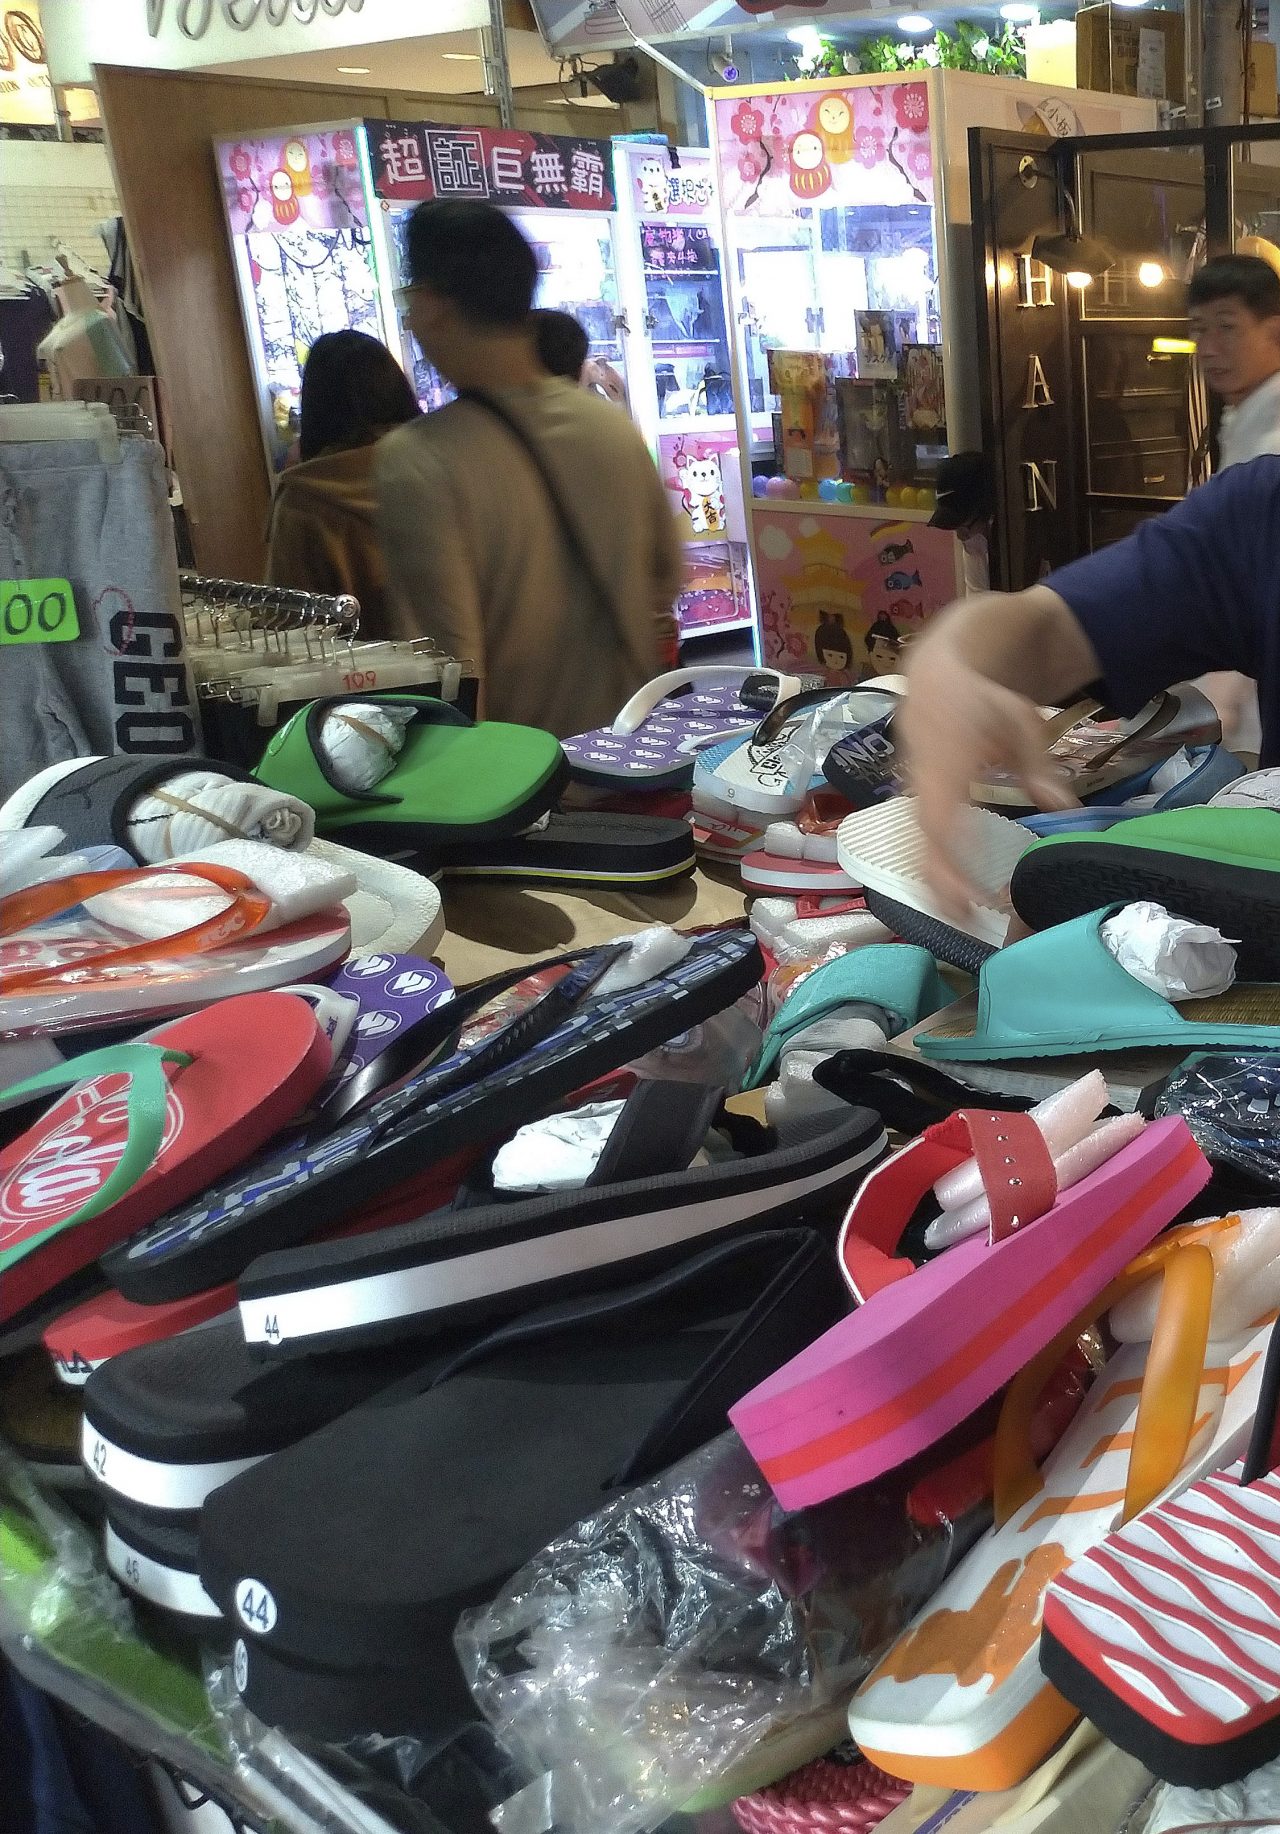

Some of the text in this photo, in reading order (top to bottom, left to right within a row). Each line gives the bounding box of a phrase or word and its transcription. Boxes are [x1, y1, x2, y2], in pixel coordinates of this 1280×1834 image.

[342, 670, 376, 690] 109
[727, 788, 736, 799] 9
[265, 1314, 280, 1338] 44
[93, 1440, 107, 1477] 42
[243, 1587, 270, 1629] 44
